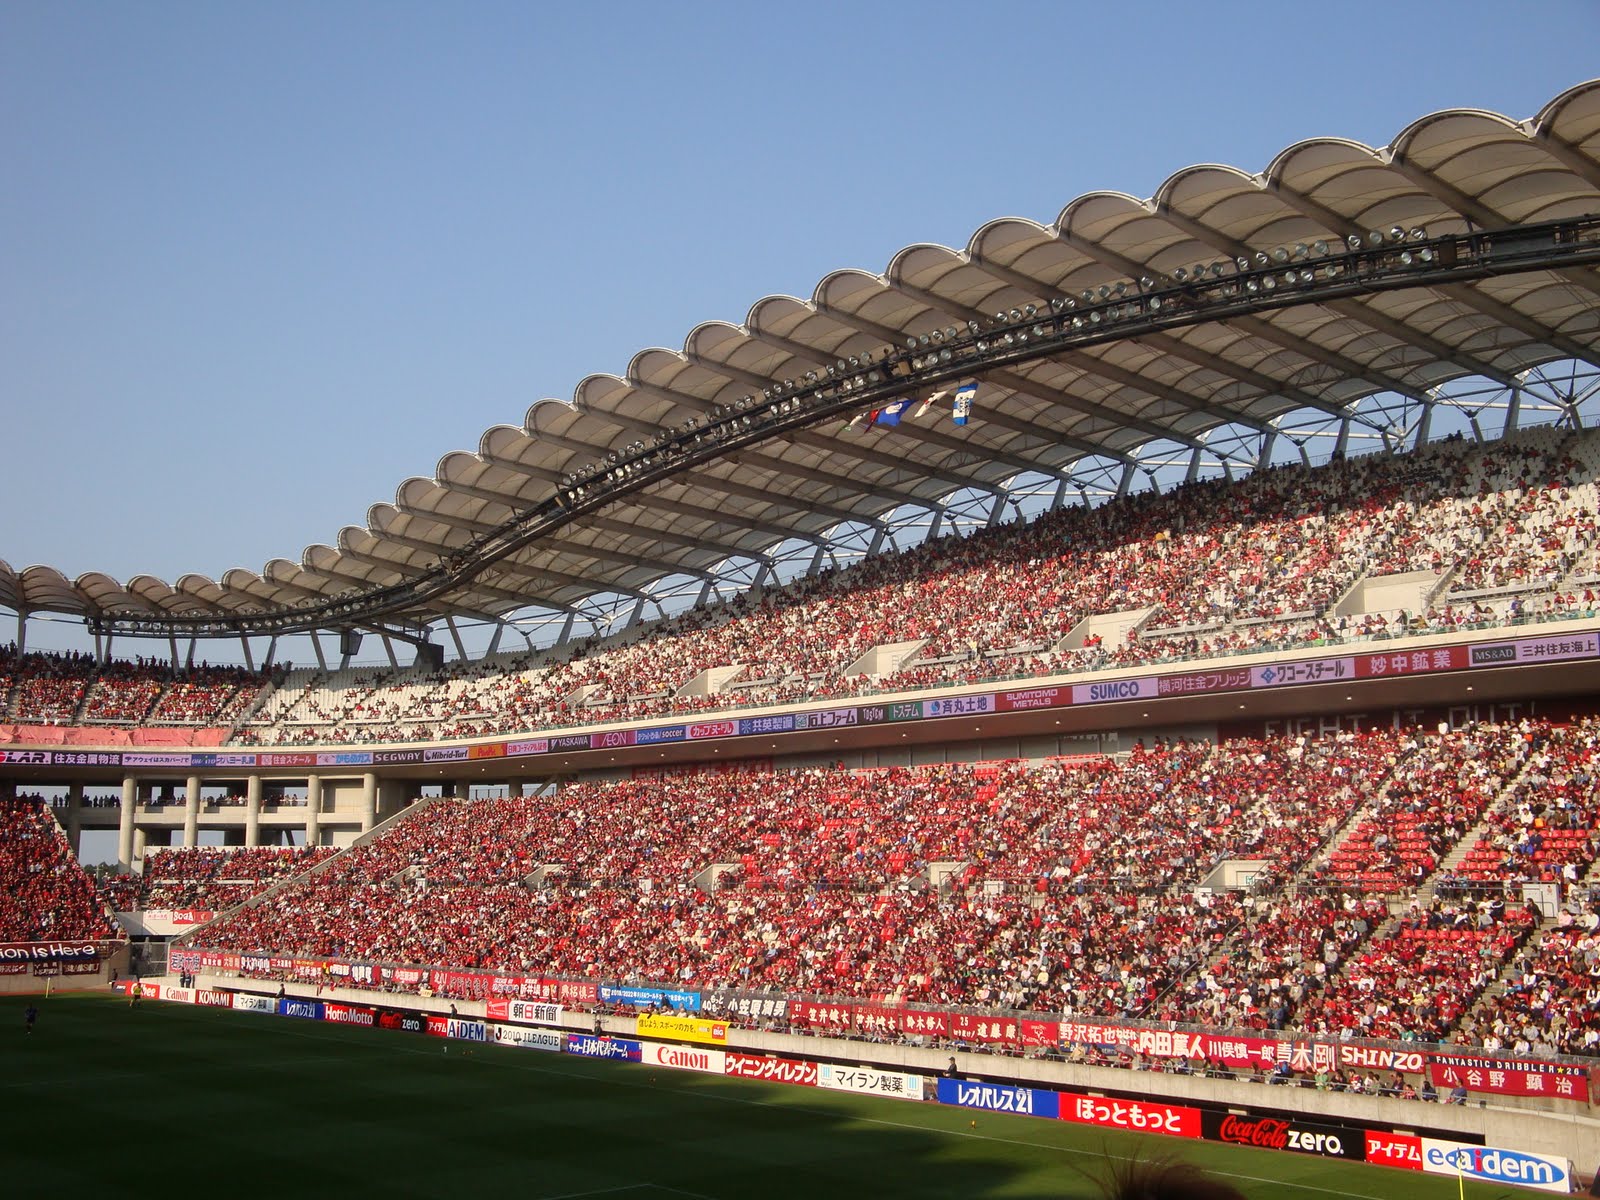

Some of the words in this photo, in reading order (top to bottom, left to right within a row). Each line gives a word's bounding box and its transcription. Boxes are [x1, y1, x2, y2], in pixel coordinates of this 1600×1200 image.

[1474, 648, 1514, 662] MS&AD
[1521, 640, 1597, 657] 三井住友海上
[1276, 659, 1345, 684] ワコースチール
[1370, 650, 1451, 674] 妙中鉱業
[1090, 681, 1140, 700] SUMCO
[1158, 671, 1251, 693] 横河住金ブリッジ
[1006, 688, 1059, 701] SUMITOMO
[1012, 697, 1052, 709] METALS
[807, 711, 856, 728] 石上ファーム
[892, 704, 920, 719] トステム
[692, 722, 732, 737] カップヌードル
[751, 716, 793, 732] 共英製鋼
[558, 735, 589, 748] YASKAWA
[54, 753, 120, 765] 住友金属物流
[273, 755, 312, 765] 住金スチール
[374, 751, 421, 762] SEGWAY
[50, 943, 96, 957] Here
[166, 987, 189, 1001] Canon
[198, 990, 230, 1007] KONAMI
[512, 1003, 559, 1022] 朝日新聞
[727, 998, 786, 1017] 小笠原満男
[428, 1022, 447, 1033] アイテム
[448, 1019, 485, 1041] AiDEM
[959, 1016, 969, 1026] 25
[523, 1031, 560, 1047] J.LEAGUE
[1059, 1022, 1118, 1045] 野沢拓也
[1139, 1030, 1205, 1059] 内田篤人
[1208, 1040, 1275, 1062] 川俣慎一郎
[657, 1046, 709, 1070] Canon
[1340, 1045, 1422, 1070] SHINZO
[1435, 1055, 1491, 1069] FANTASTIC
[1496, 1061, 1556, 1074] DRIBBLER
[725, 1054, 818, 1084] ウイニングイレブン
[834, 1070, 904, 1094] マイラン製薬
[957, 1083, 1033, 1114] レオパレス21
[1076, 1097, 1182, 1133] ほっともっと
[1367, 1138, 1422, 1162] アイテム
[1427, 1145, 1553, 1184] e-aidem
